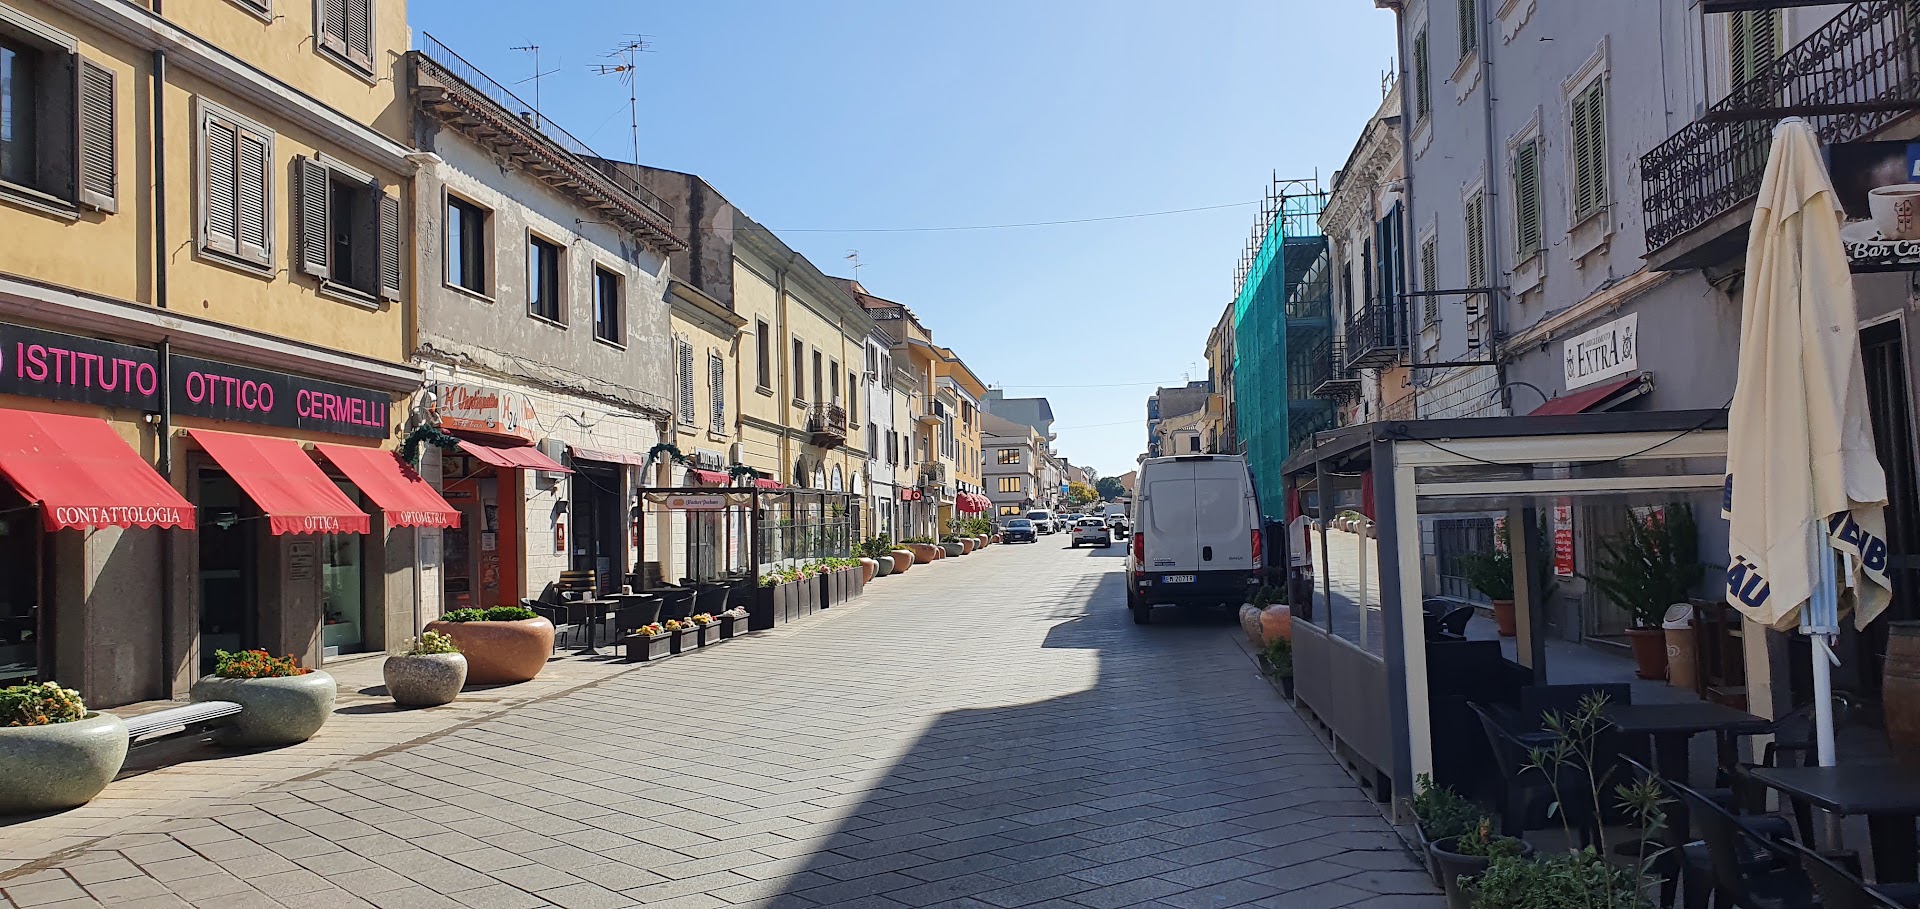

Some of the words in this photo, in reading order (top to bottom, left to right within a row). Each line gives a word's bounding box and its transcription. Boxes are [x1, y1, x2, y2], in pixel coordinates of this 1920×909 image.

[1848, 240, 1891, 259] Bar
[17, 342, 157, 396] ISTITUTO
[186, 371, 274, 412] OTTICO
[296, 389, 385, 428] CERMELLI
[56, 506, 181, 524] CONTATTOLOGIA
[304, 516, 339, 530] OTTICA
[400, 511, 447, 524] OPTOMETRIA
